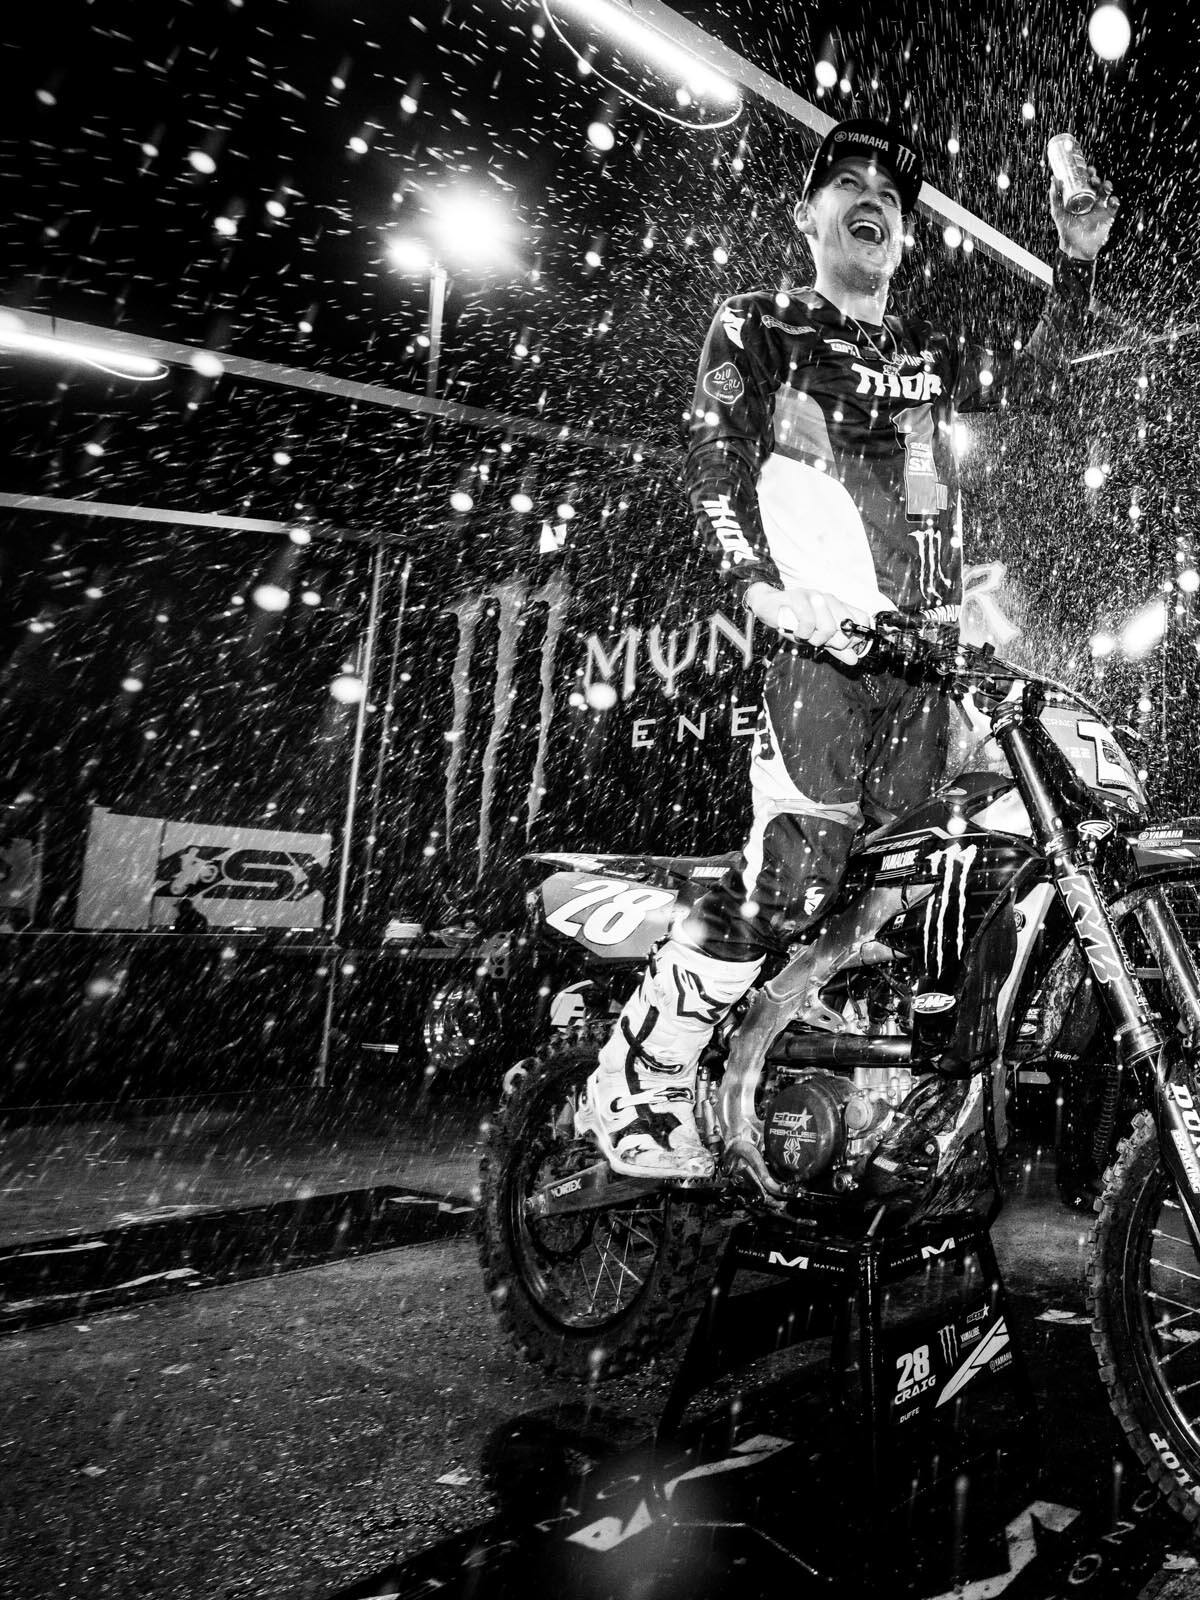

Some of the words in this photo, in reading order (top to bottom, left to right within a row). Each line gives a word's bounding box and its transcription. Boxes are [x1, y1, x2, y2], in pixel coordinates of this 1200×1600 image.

[847, 132, 890, 152] YAMAHA
[1149, 829, 1183, 839] YAMAHA
[546, 879, 676, 946] 28
[813, 1262, 845, 1273] MATRIX
[890, 1253, 920, 1268] MATRIX
[896, 1344, 931, 1391] 28
[894, 1374, 936, 1405] CRAIG
